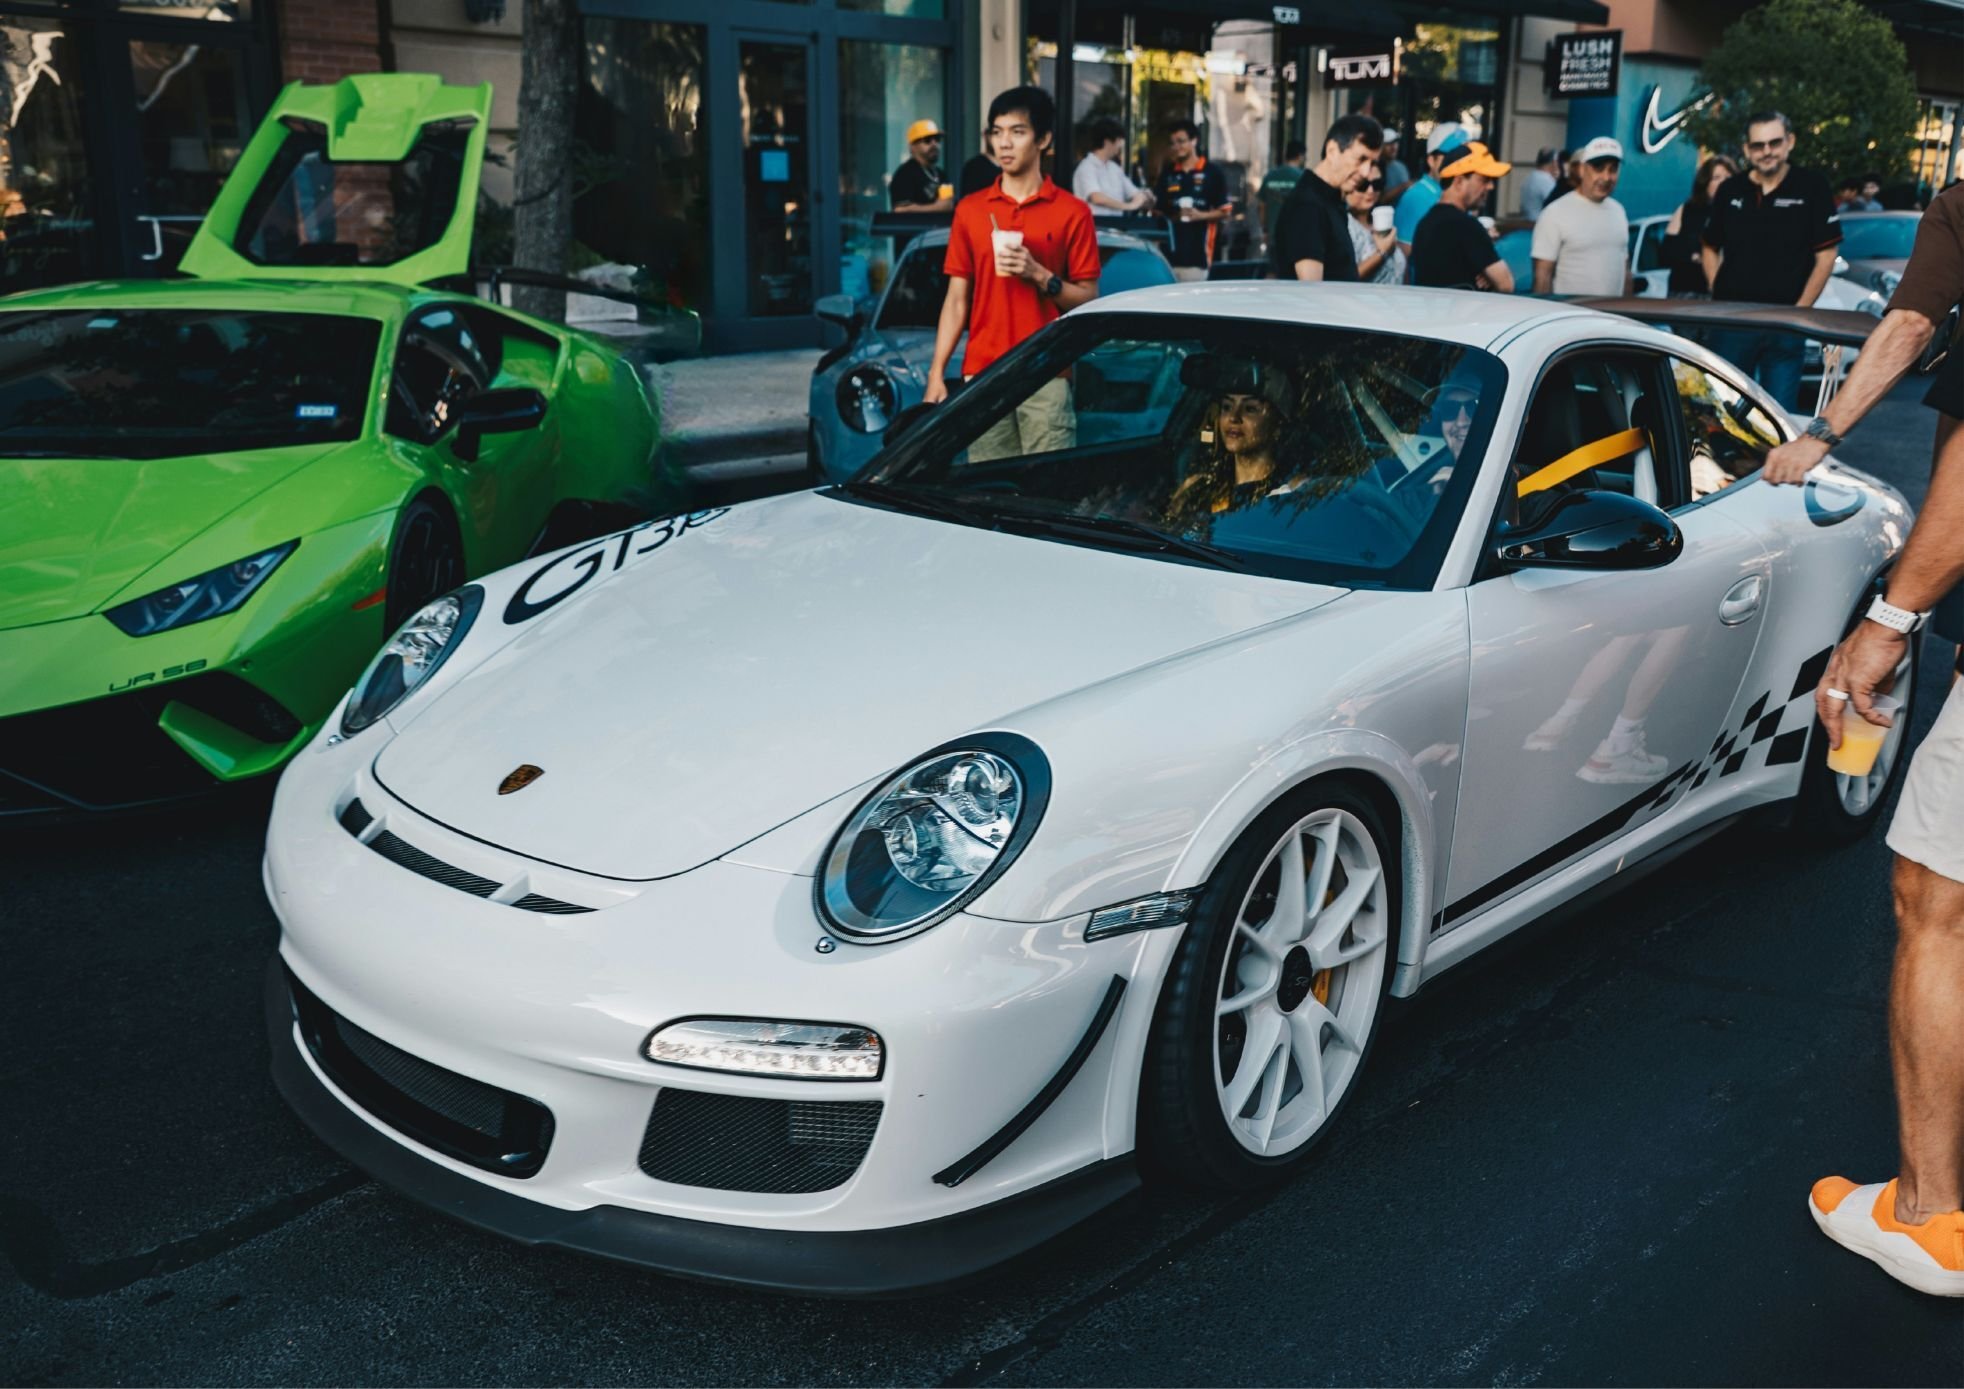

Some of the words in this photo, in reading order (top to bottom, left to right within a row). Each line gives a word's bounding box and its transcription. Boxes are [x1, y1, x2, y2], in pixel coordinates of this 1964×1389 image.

[1563, 38, 1613, 57] LUSH
[1329, 54, 1390, 81] TUMI
[1561, 57, 1611, 74] FRESH
[109, 672, 155, 692] UR
